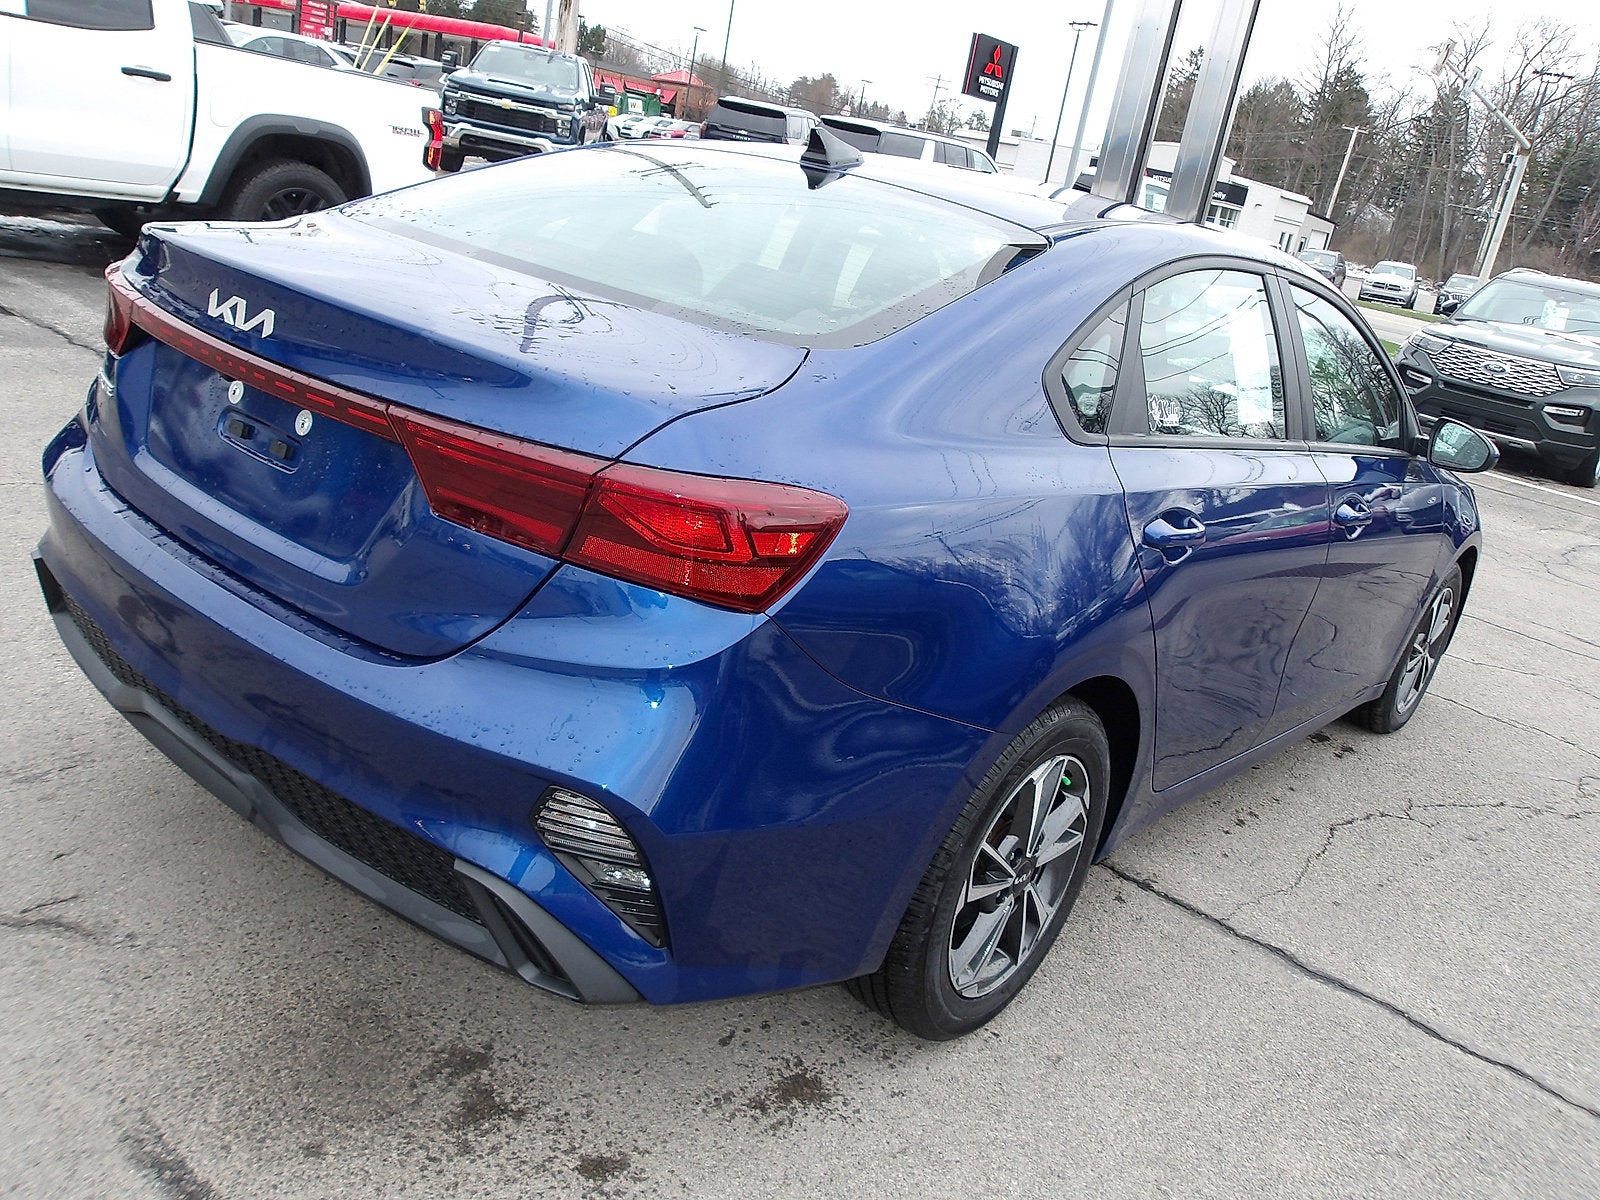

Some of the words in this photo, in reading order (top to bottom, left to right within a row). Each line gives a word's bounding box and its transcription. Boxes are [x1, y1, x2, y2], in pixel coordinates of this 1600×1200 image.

[978, 75, 1004, 90] MITSUBISHI
[979, 85, 999, 97] MOTORS
[1212, 191, 1227, 200] elly
[207, 288, 275, 339] KIA
